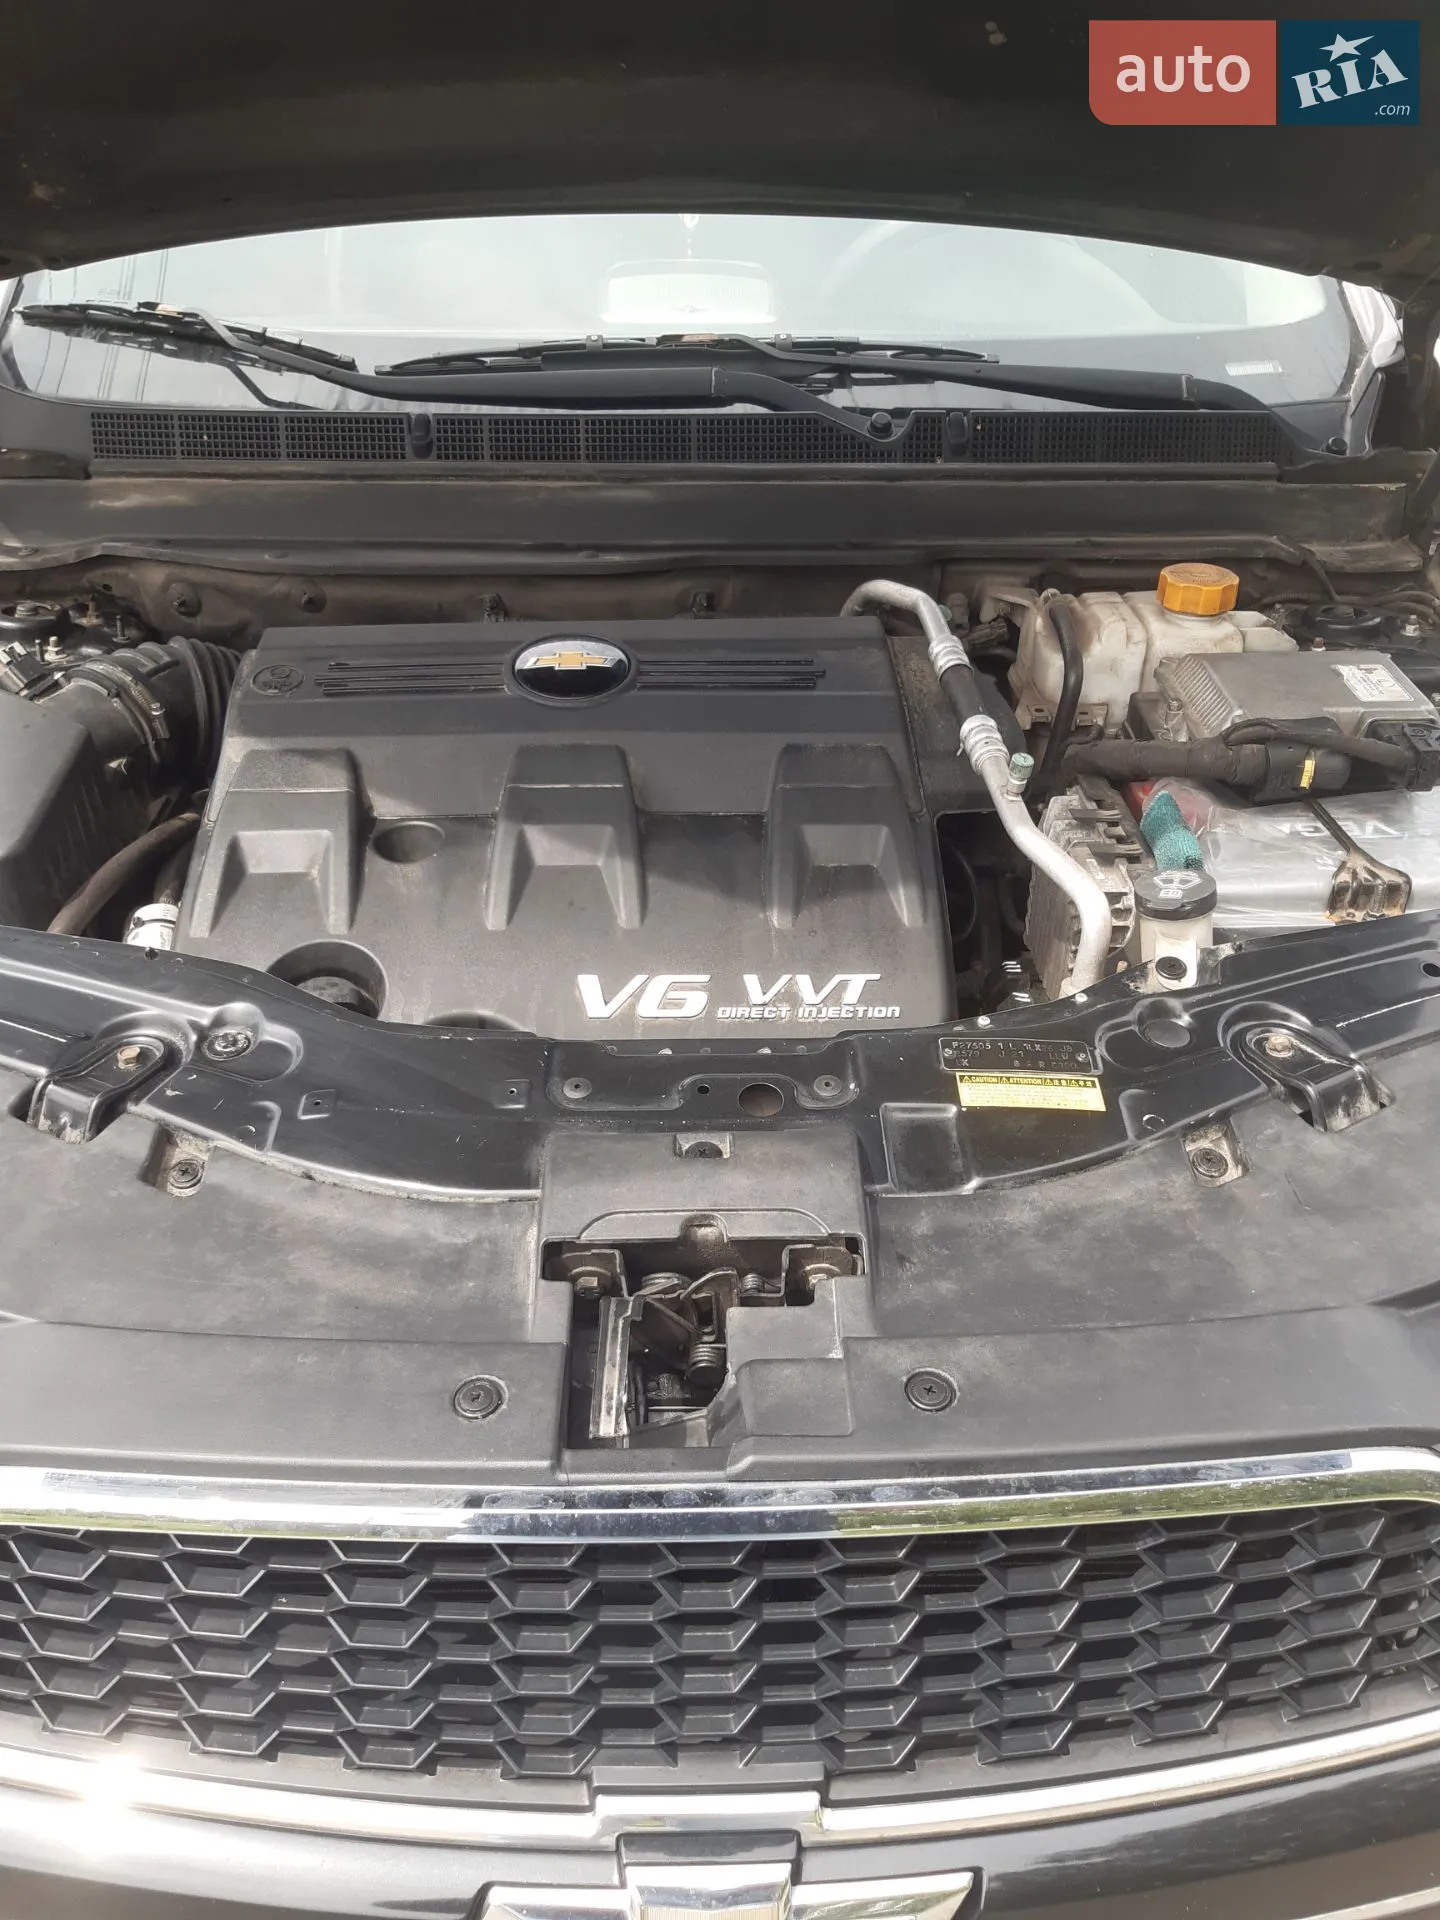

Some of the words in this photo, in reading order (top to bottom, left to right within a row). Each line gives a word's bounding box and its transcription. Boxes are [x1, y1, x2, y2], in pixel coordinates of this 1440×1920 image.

[577, 973, 712, 1019] V6
[742, 973, 882, 1006] VVT
[717, 1006, 791, 1020] DIRECT
[795, 1006, 901, 1020] INJECTION
